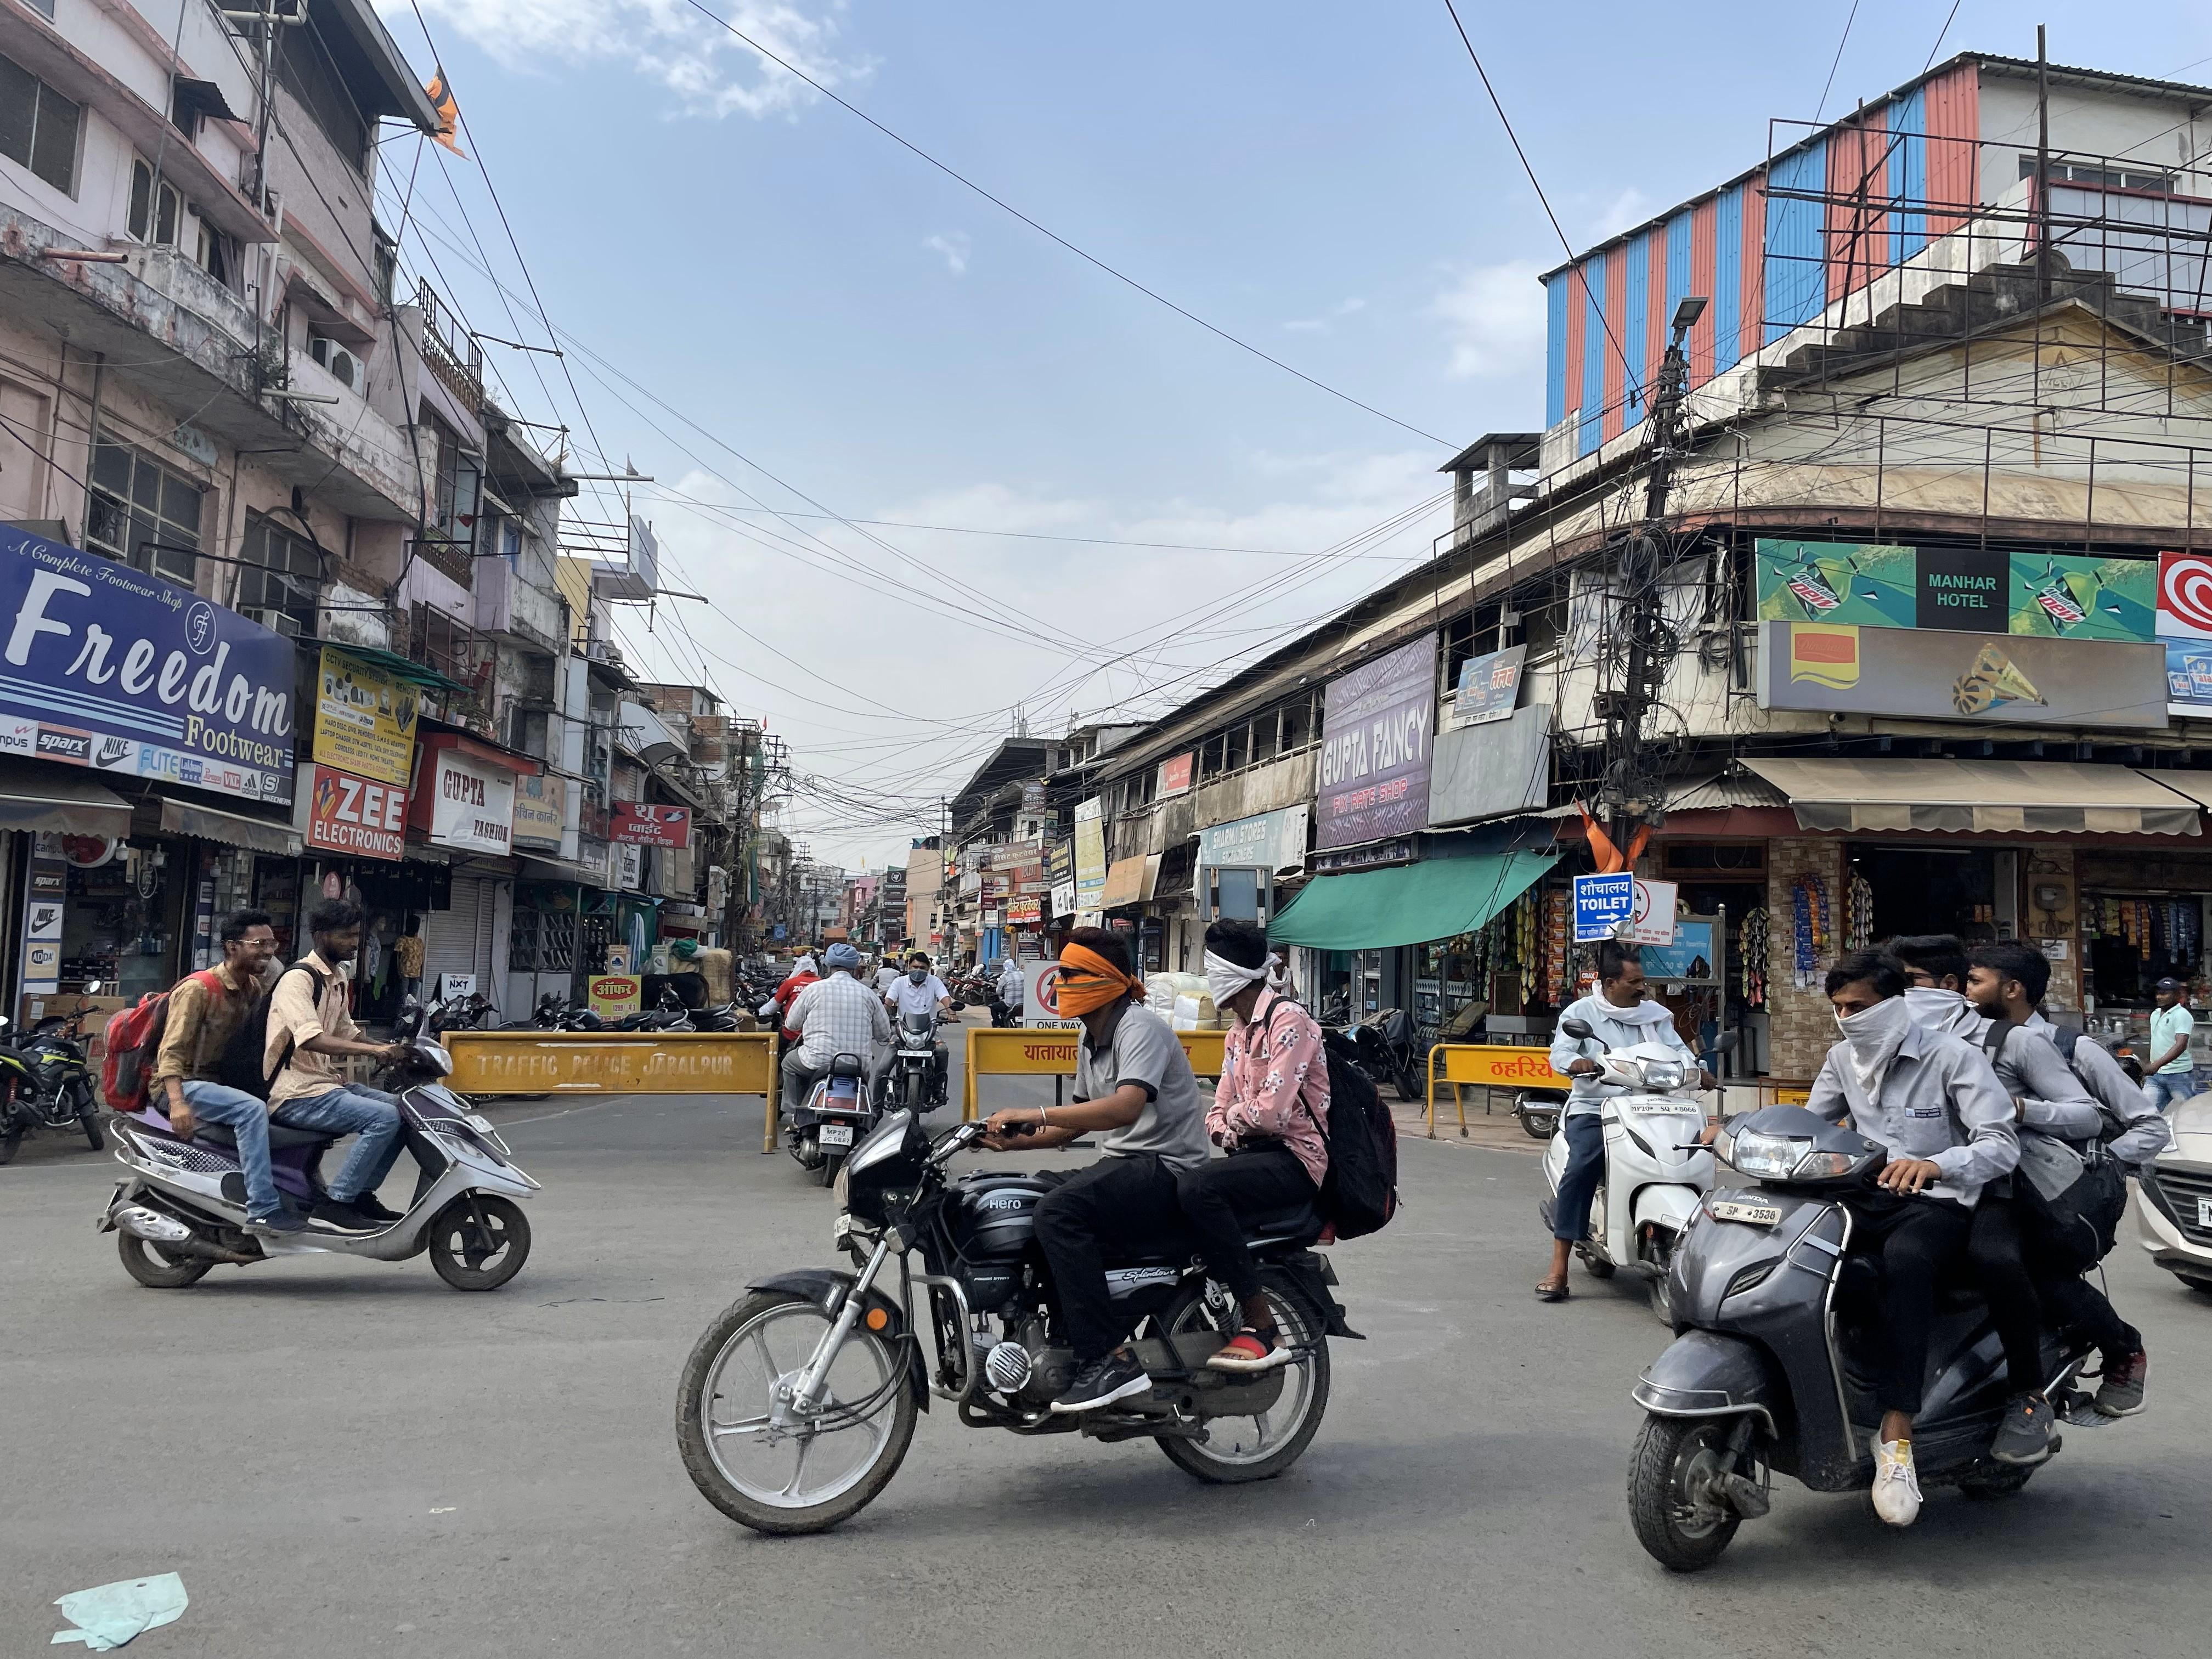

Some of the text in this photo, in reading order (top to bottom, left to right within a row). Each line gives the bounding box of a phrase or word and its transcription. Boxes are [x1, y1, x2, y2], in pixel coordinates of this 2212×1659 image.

[8, 540, 183, 612] A Complete Footwear Shop
[1928, 574, 1997, 590] MANHAR
[1795, 574, 1837, 600] Mountain
[1937, 592, 1989, 608] HOTEL
[2044, 586, 2083, 615] Mountain
[5, 568, 291, 737] Freedom
[326, 653, 341, 666] CCTV
[342, 660, 368, 679] SECURITY
[396, 682, 417, 698] REMOTE
[325, 719, 336, 727] HARD
[184, 714, 284, 769] Footwear
[320, 729, 335, 737] LAPTOP
[38, 733, 90, 753] sparx
[103, 737, 129, 756] NIKE
[1323, 699, 1429, 787] GUPTA FANCY
[140, 748, 179, 775] FLITE
[180, 757, 203, 774] Lakhani
[327, 752, 350, 765] ELECTRONIC
[350, 758, 361, 768] SPARE
[362, 763, 372, 771] PARTS
[224, 772, 240, 788] VKC
[443, 769, 485, 807] GUPTA
[242, 787, 259, 797] adidas
[262, 794, 292, 806] SKECHERS
[1333, 778, 1408, 817] FIX RATE SHOP
[335, 777, 405, 832] ZEE
[634, 804, 661, 823] शू
[313, 819, 402, 854] ELECTRONICS
[473, 819, 509, 842] FASHION
[1212, 826, 1238, 850] SHARMA
[1239, 820, 1267, 845] STORES
[34, 877, 62, 887] sparx
[1580, 879, 1630, 895] शौचालय
[1579, 896, 1629, 911] TOILET
[36, 909, 55, 922] NIKE
[32, 952, 53, 962] ADDA
[449, 980, 469, 990] NXT
[596, 981, 633, 996] ऑफर
[1037, 1021, 1082, 1029] ONE WAY
[477, 1055, 557, 1076] TRAFFIC
[1489, 1056, 1554, 1079] ठहरिये
[989, 1199, 1022, 1210] Hero
[1735, 1195, 1769, 1205] HONDA
